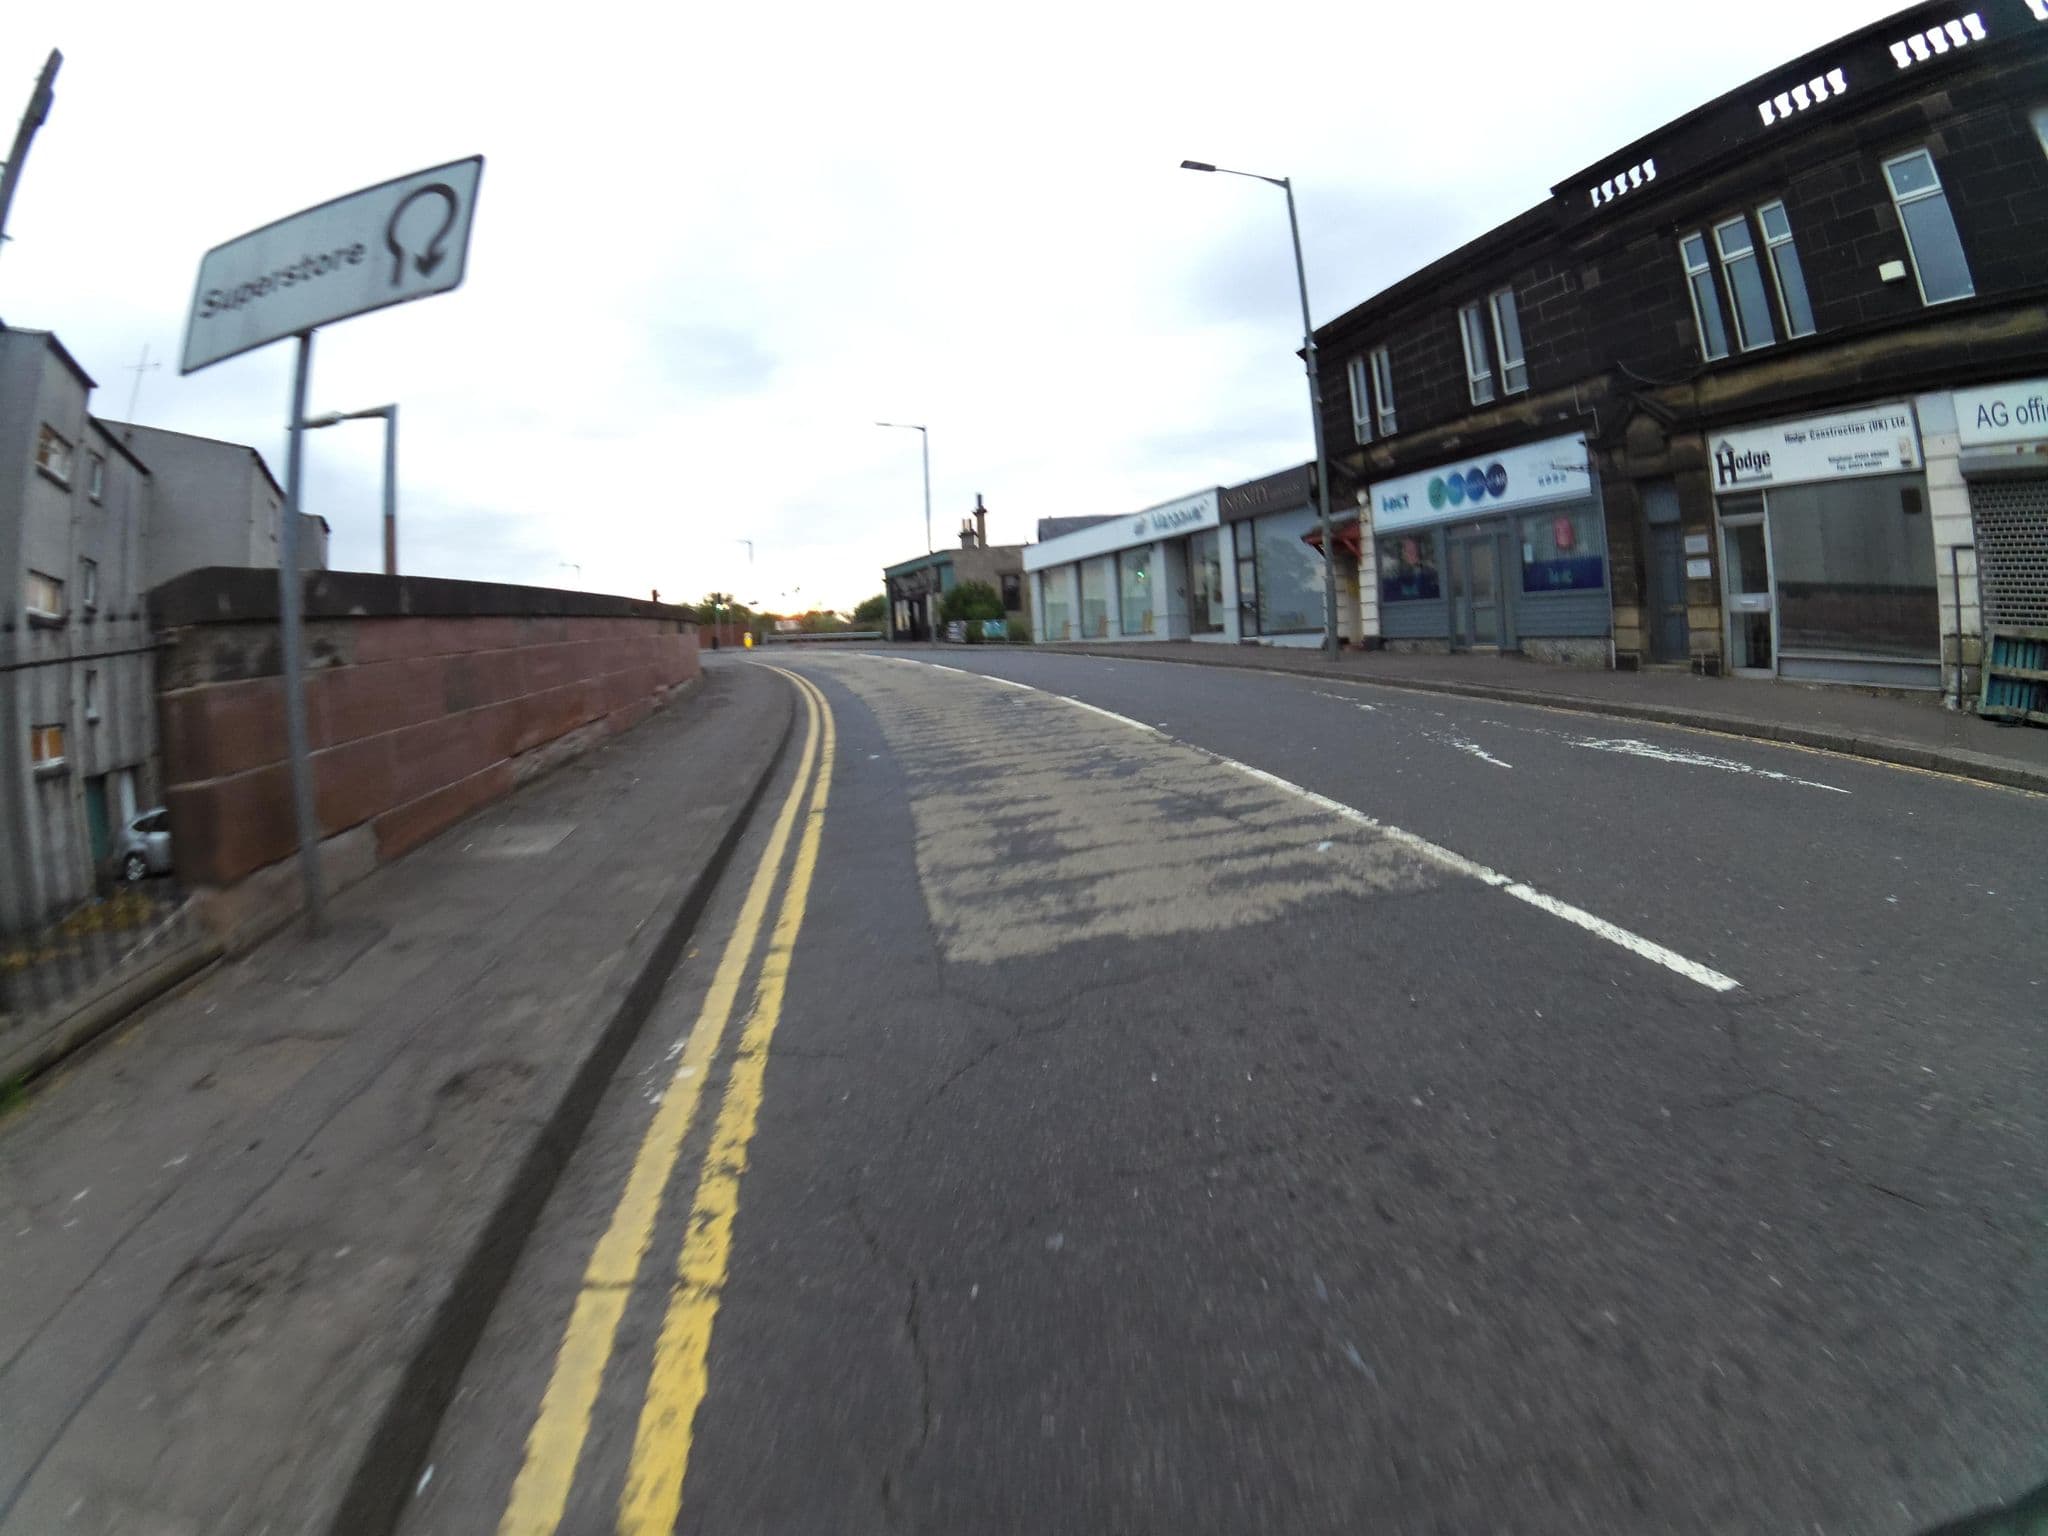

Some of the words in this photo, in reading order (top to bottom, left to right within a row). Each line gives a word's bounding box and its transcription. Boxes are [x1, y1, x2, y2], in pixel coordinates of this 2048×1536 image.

[200, 242, 364, 319] Superstore
[1809, 423, 1866, 441] Construction
[1869, 418, 1888, 433] (UK)
[1977, 400, 2009, 429] AG
[2015, 395, 2048, 425] offi
[1715, 448, 1771, 485] Hodge
